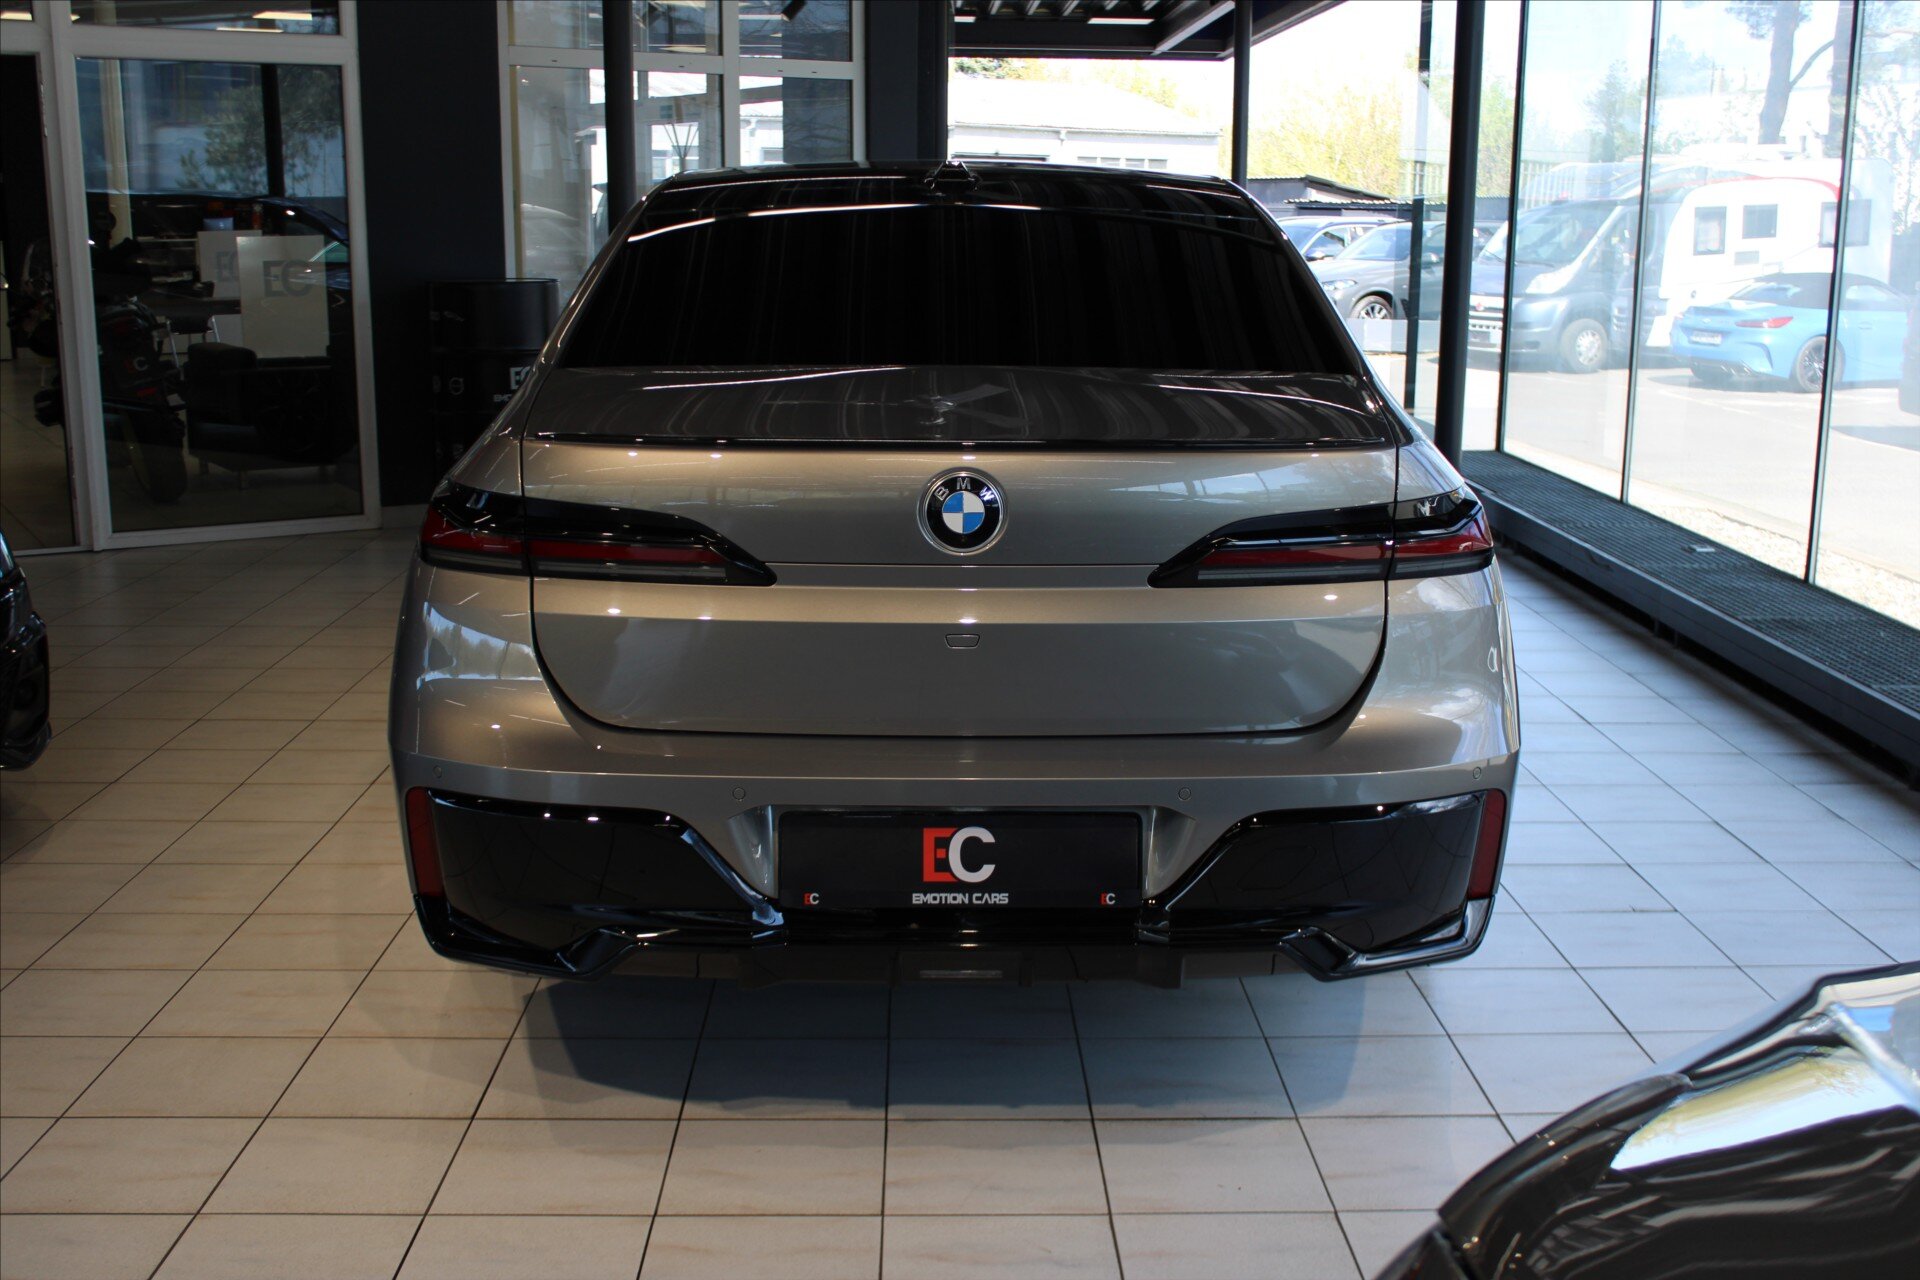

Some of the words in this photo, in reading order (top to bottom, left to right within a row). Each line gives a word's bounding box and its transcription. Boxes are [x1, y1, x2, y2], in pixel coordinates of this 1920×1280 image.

[263, 259, 311, 298] EC
[934, 478, 994, 501] BMW
[922, 826, 996, 883] EC
[804, 893, 820, 905] EC
[912, 893, 969, 905] EMOTION
[972, 893, 1009, 905] CARS
[1100, 893, 1116, 905] EC
